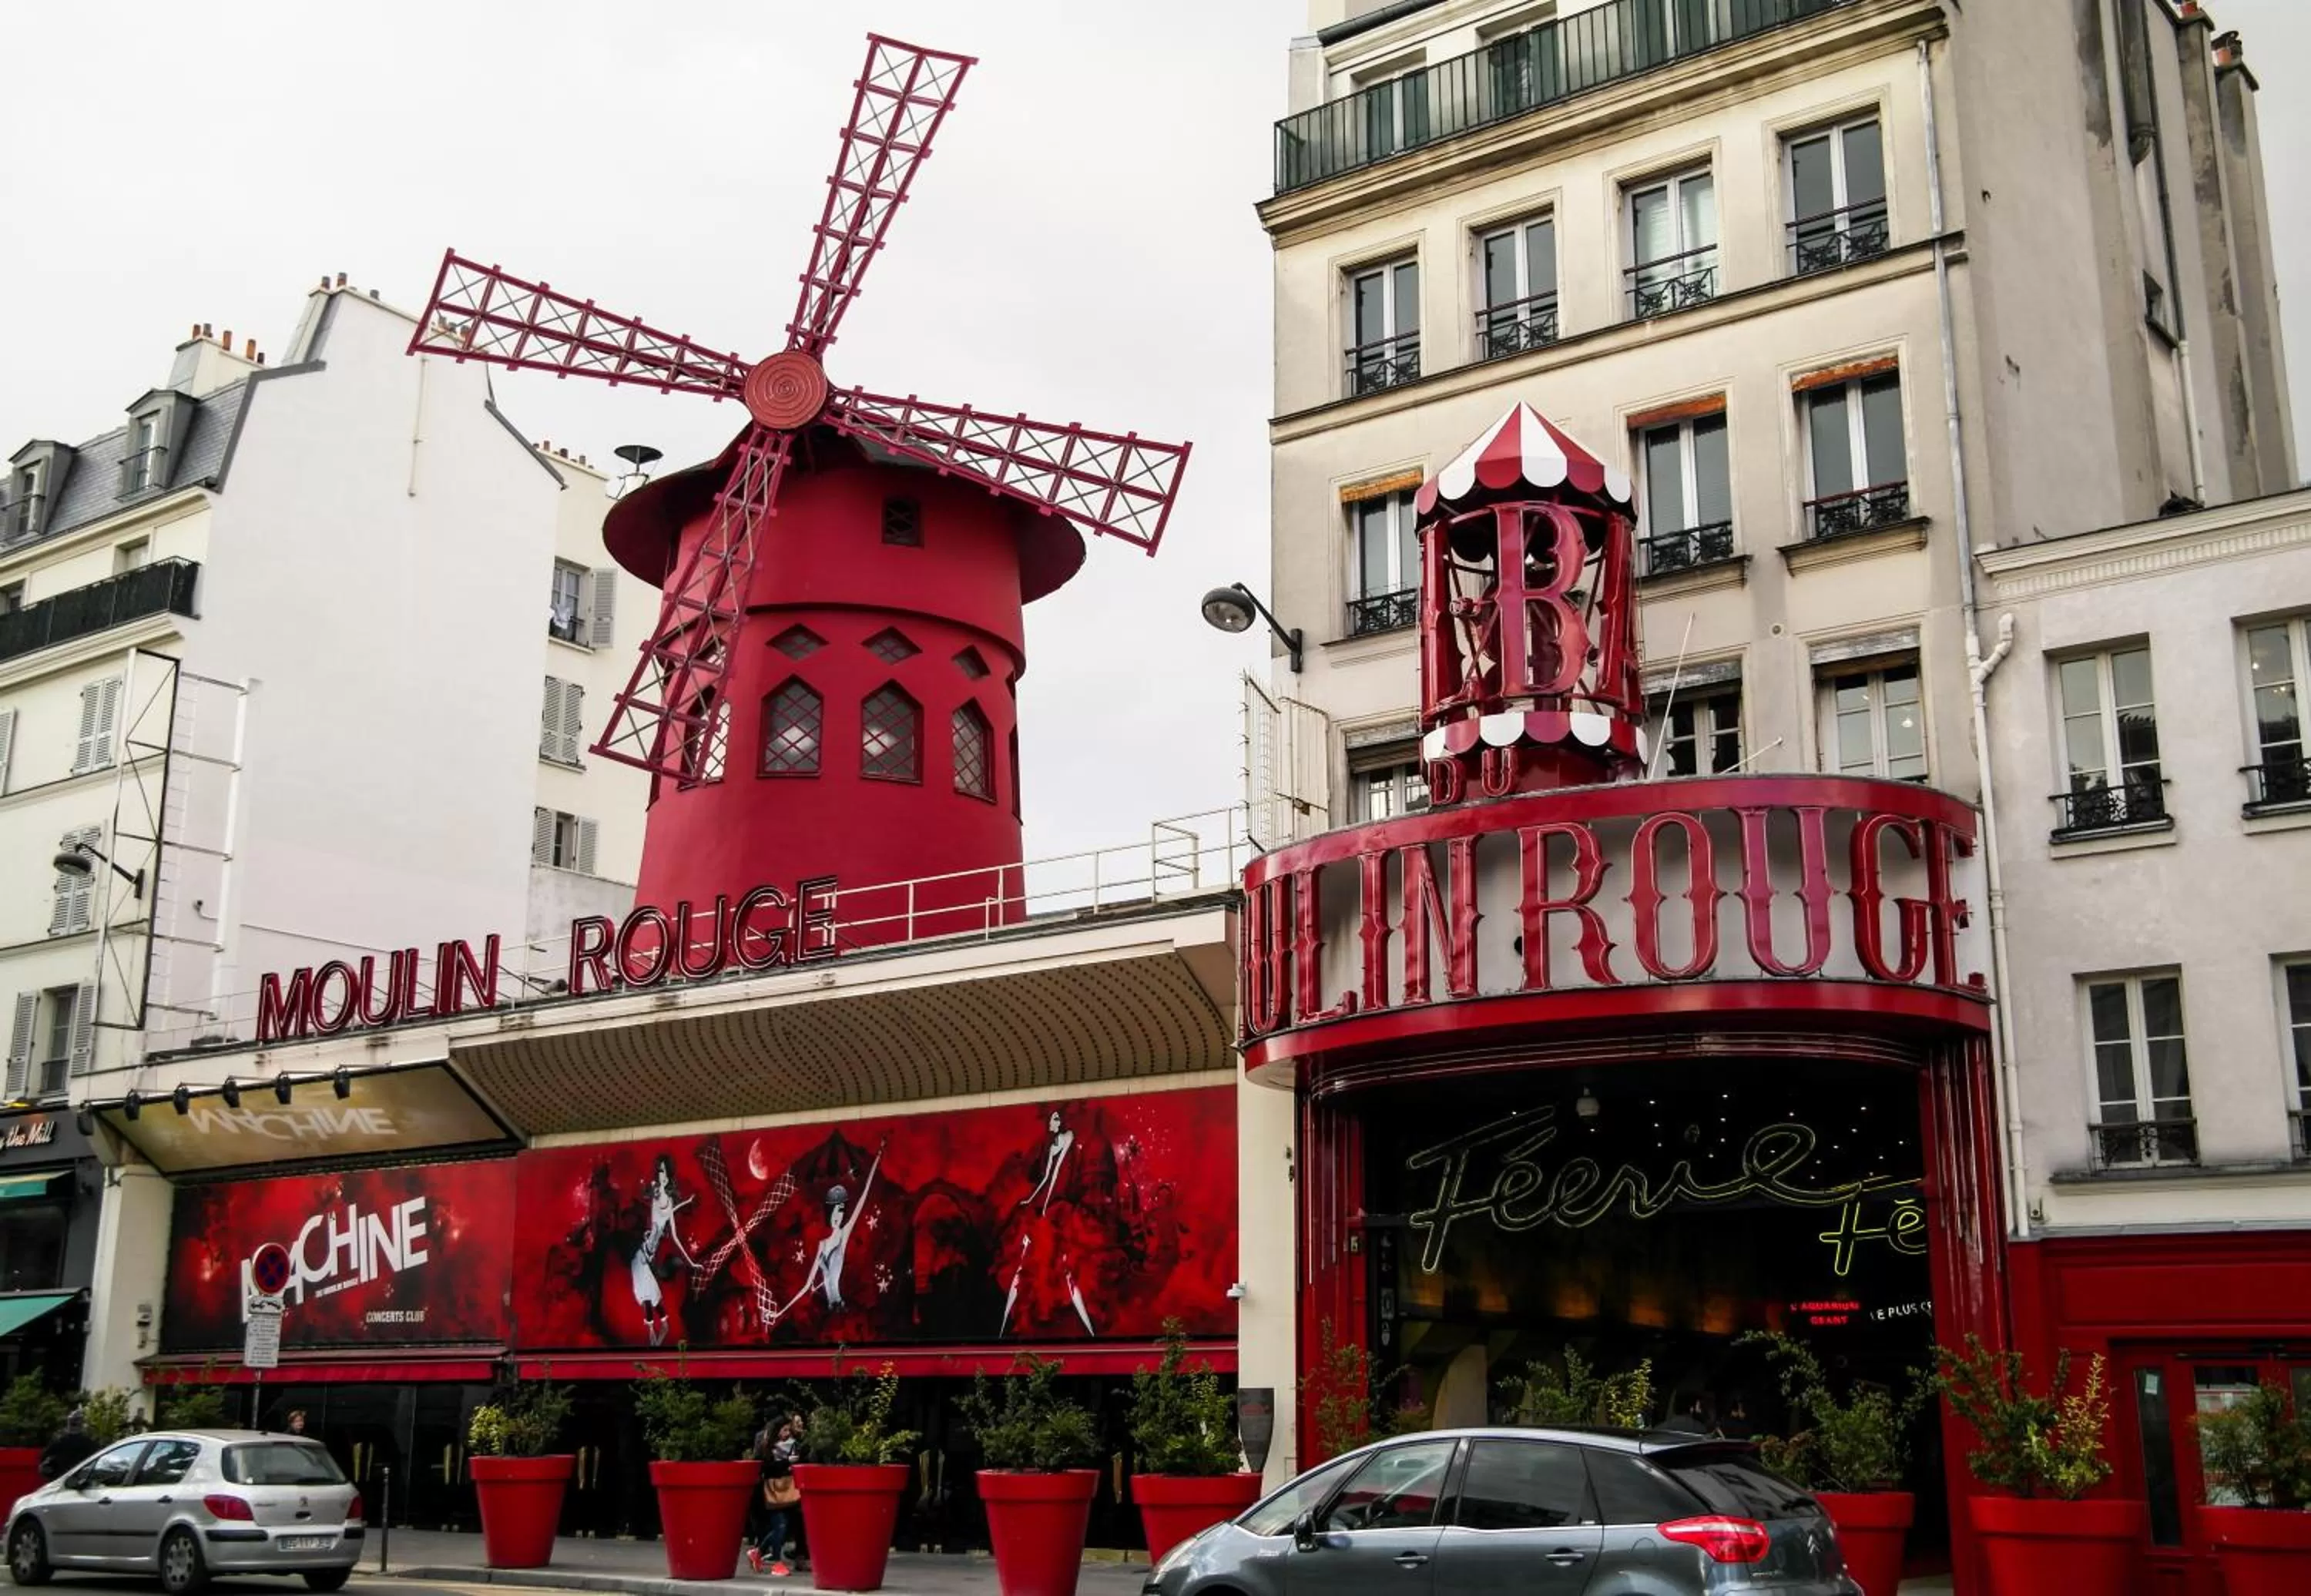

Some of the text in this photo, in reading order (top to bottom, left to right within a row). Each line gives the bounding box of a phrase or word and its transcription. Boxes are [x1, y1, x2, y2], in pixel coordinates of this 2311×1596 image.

[1427, 746, 1517, 806] DU
[256, 875, 837, 1041] MOULIN ROUGE
[1245, 806, 1987, 1035] ULIN ROUGE
[1888, 1302, 1917, 1318] PLUS
